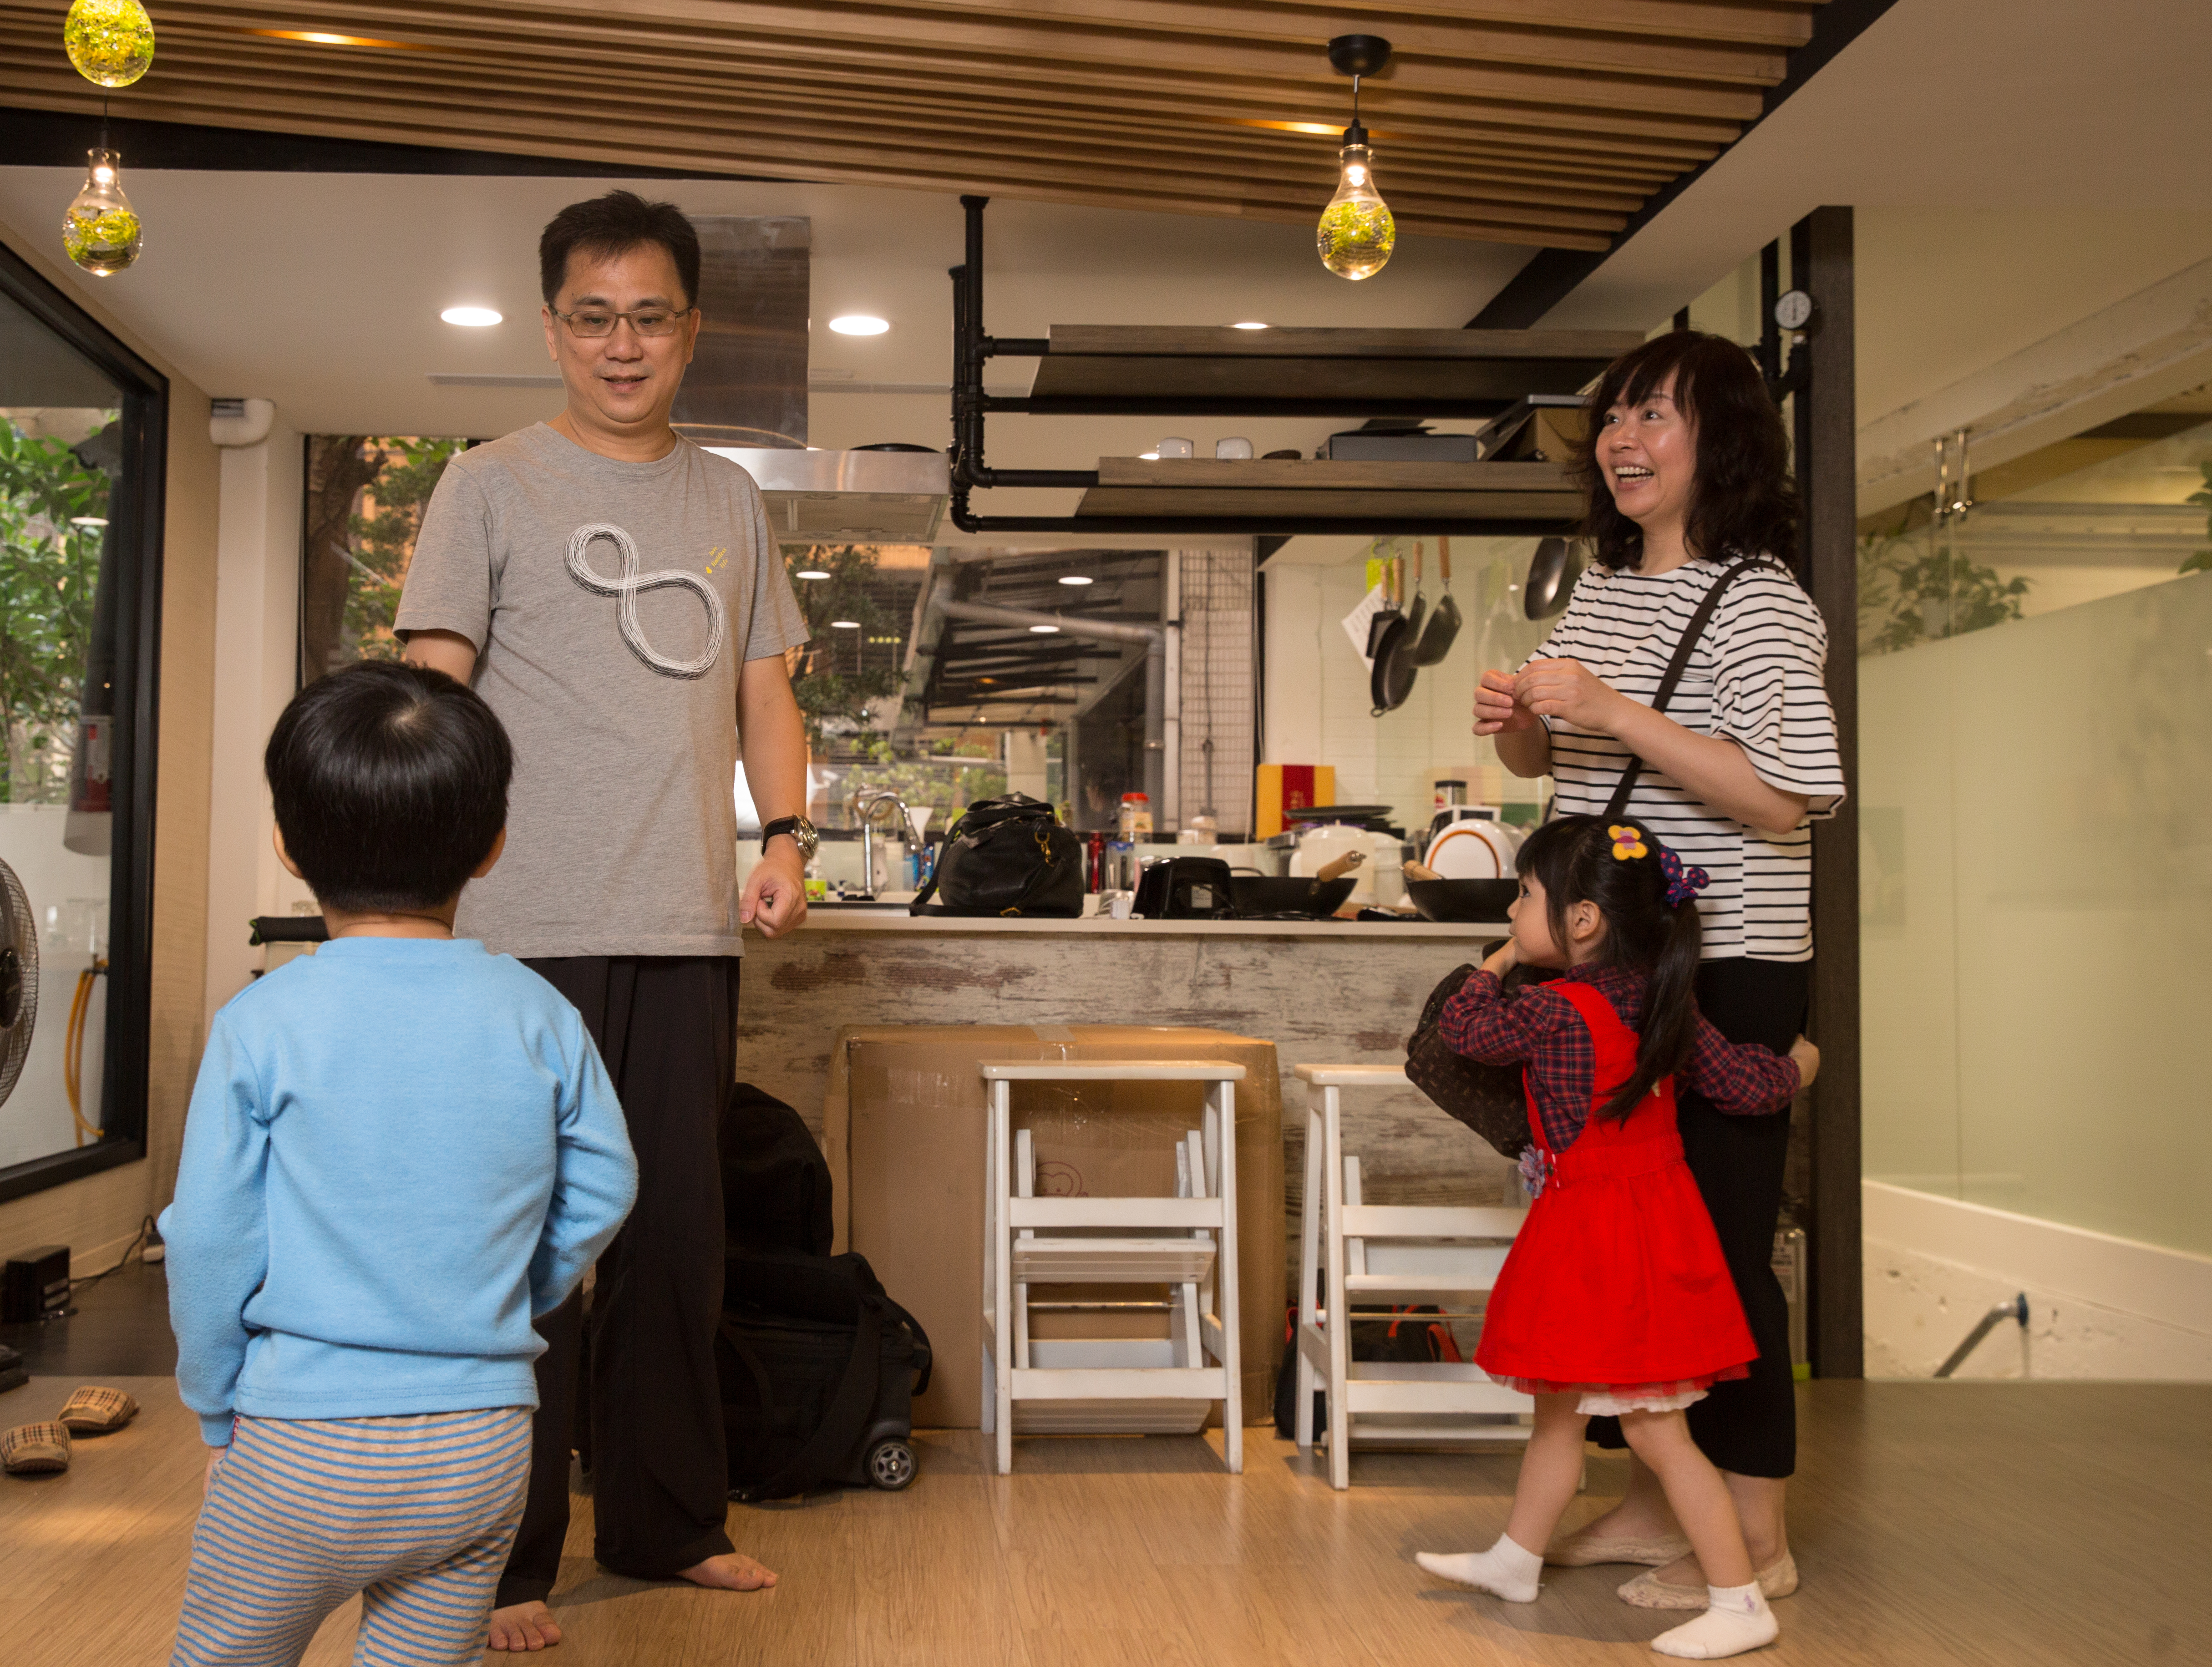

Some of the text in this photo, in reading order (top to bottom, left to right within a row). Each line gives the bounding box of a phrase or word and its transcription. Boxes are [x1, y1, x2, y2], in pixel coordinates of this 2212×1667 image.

[709, 546, 718, 556] love
[711, 547, 726, 567] limitless
[720, 559, 728, 569] life
